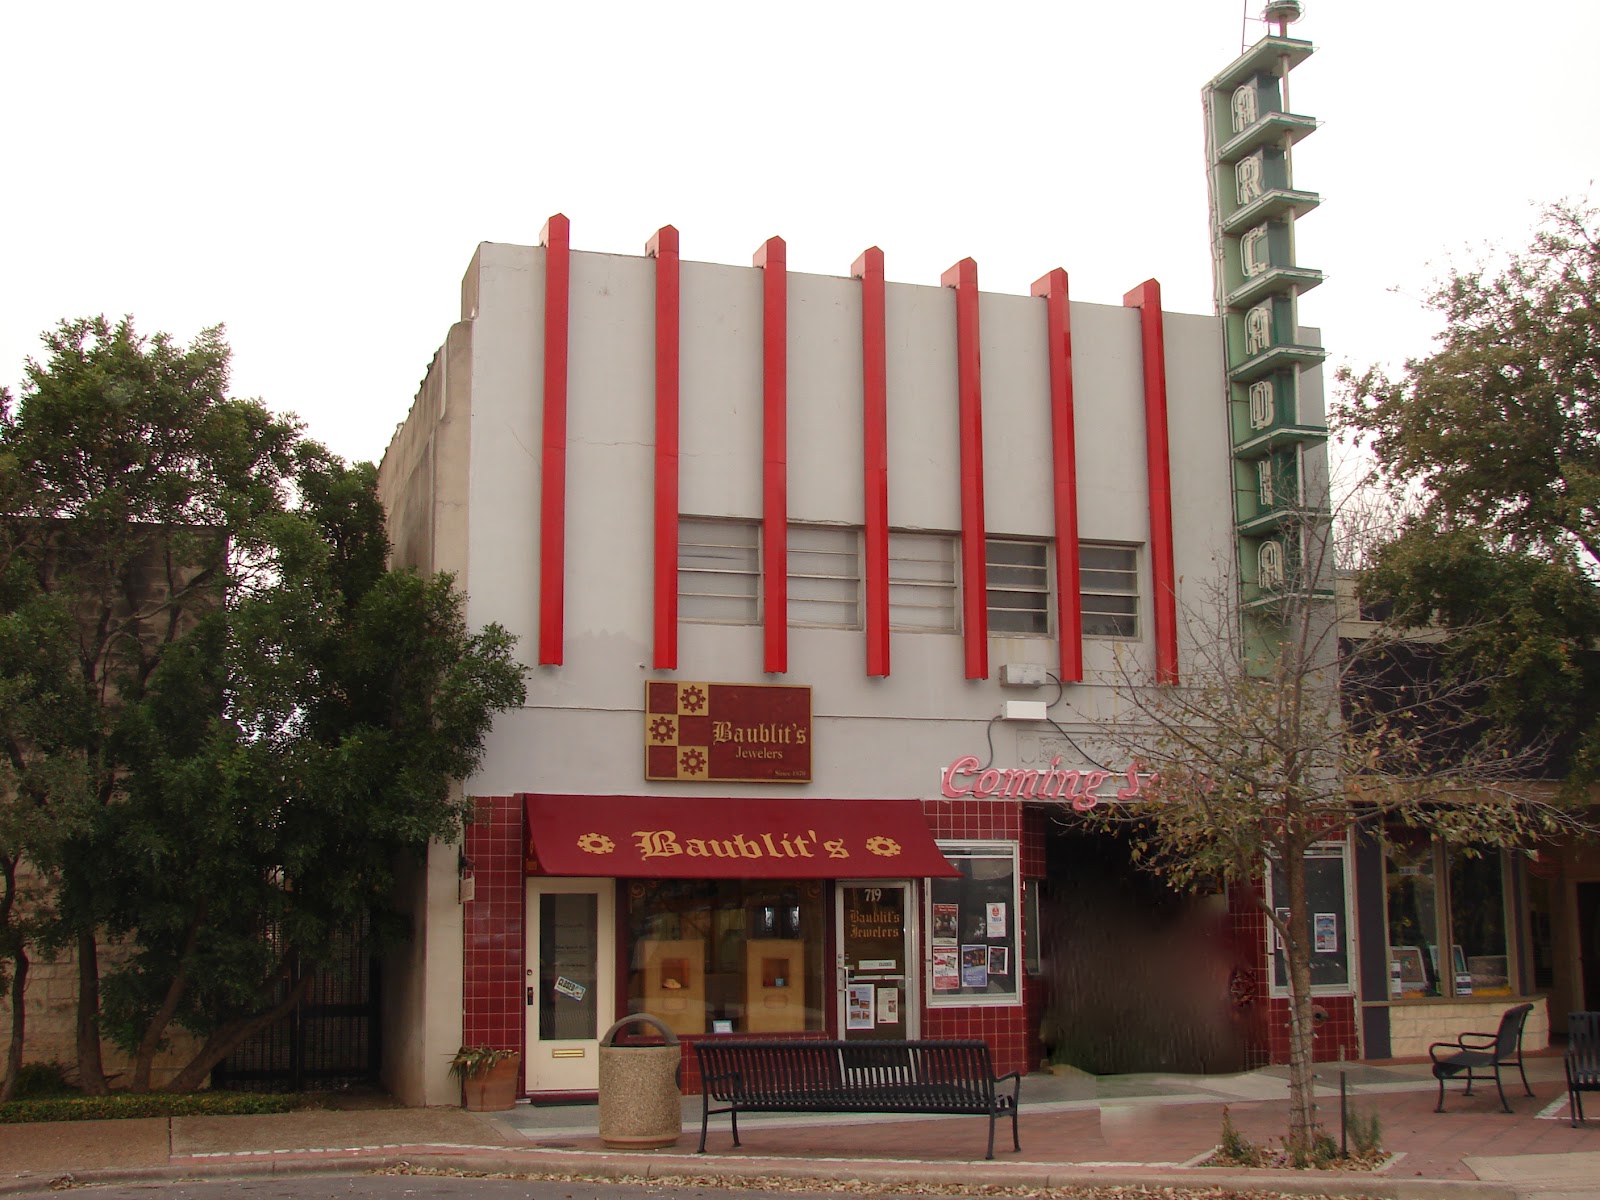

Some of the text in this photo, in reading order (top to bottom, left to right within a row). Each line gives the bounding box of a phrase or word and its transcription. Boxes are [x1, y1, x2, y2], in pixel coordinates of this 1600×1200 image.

[712, 720, 807, 746] Baublit's
[735, 746, 783, 760] Jewelers
[942, 755, 1110, 811] Coming
[631, 829, 850, 861] Baublit's
[864, 888, 882, 902] 719
[849, 909, 900, 923] Baublit's
[849, 924, 900, 938] Jewelers
[558, 978, 576, 991] CLOSED
